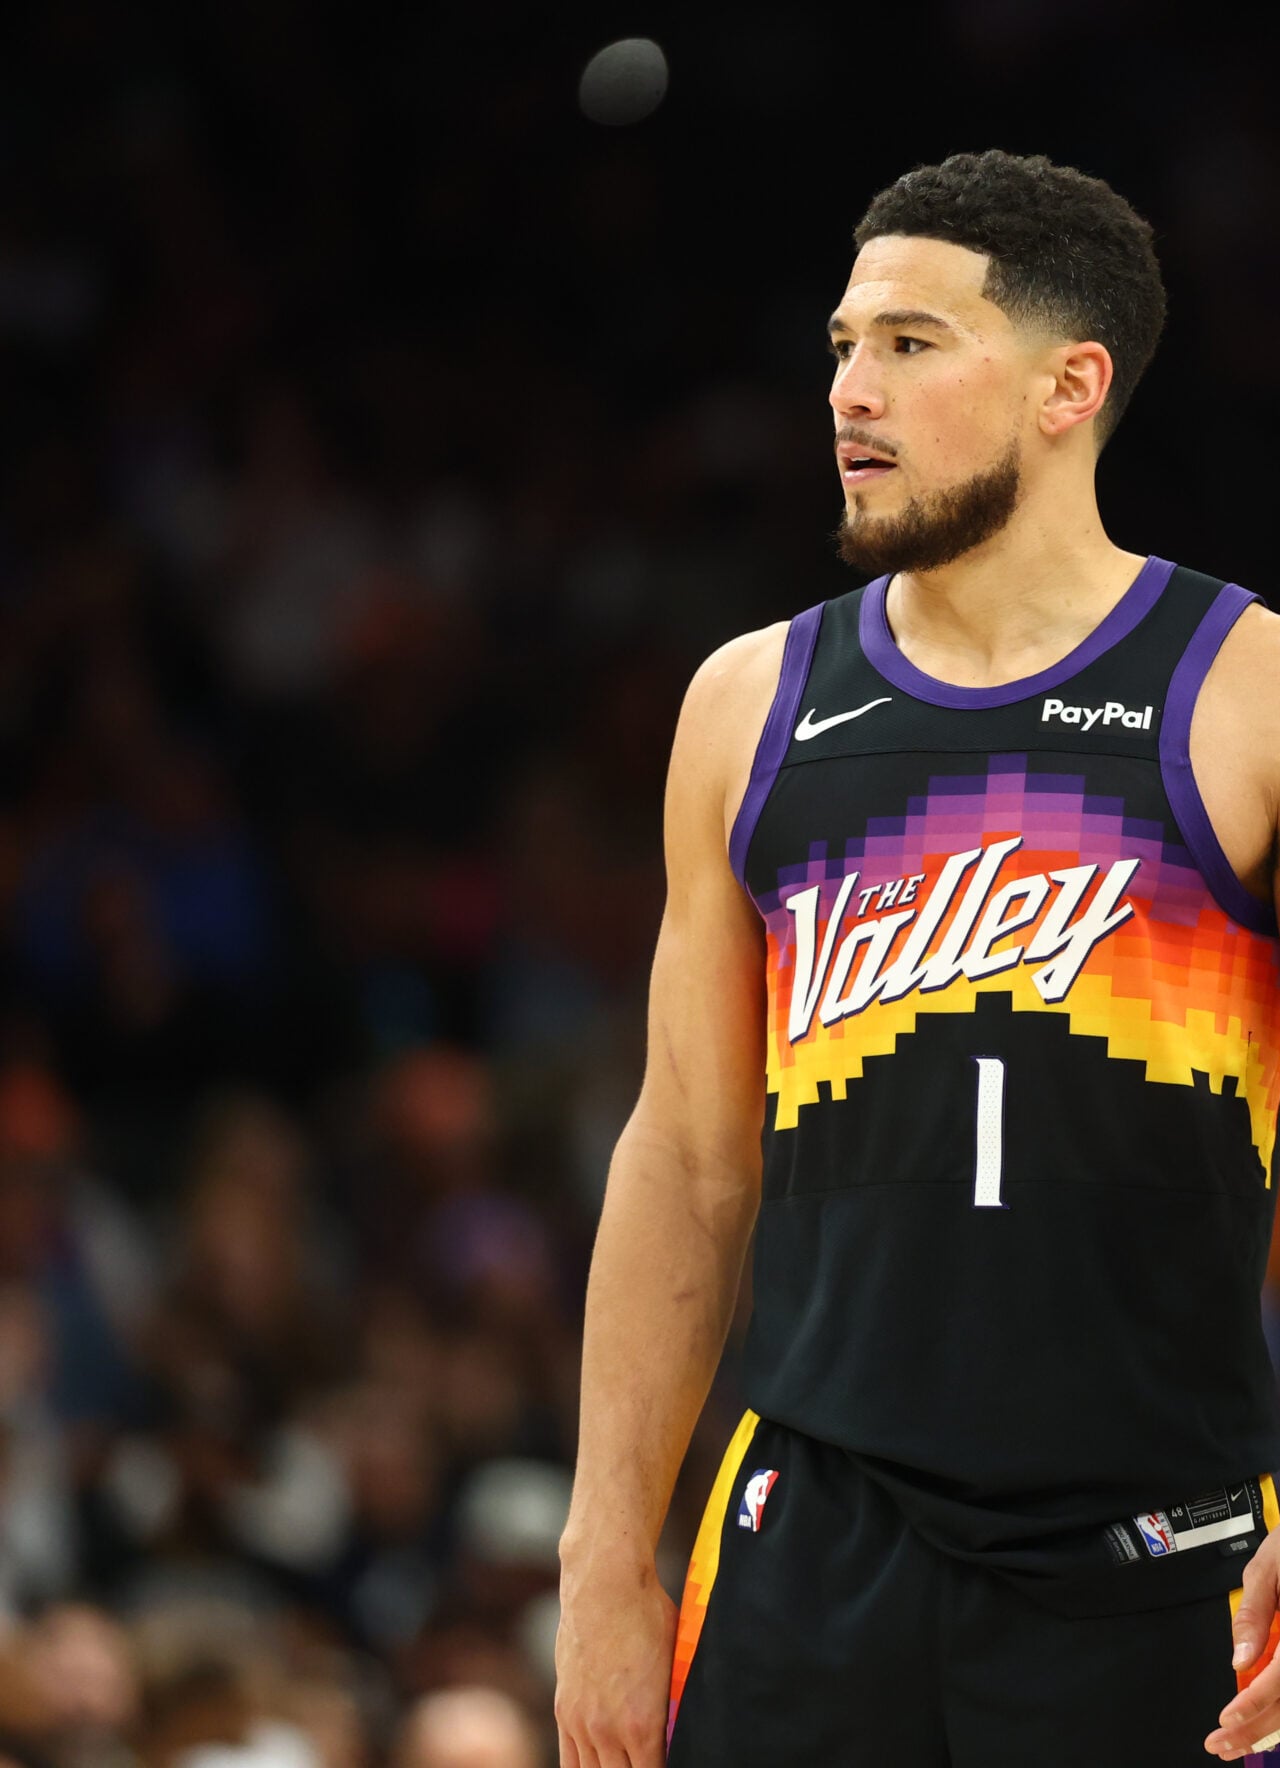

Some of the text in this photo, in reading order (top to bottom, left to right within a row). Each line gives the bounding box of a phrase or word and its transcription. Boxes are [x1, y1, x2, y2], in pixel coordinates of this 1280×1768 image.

[1041, 699, 1152, 731] PayPal
[786, 836, 1141, 1045] THE Valley
[972, 1056, 1008, 1208] 1
[1171, 1506, 1184, 1519] 48
